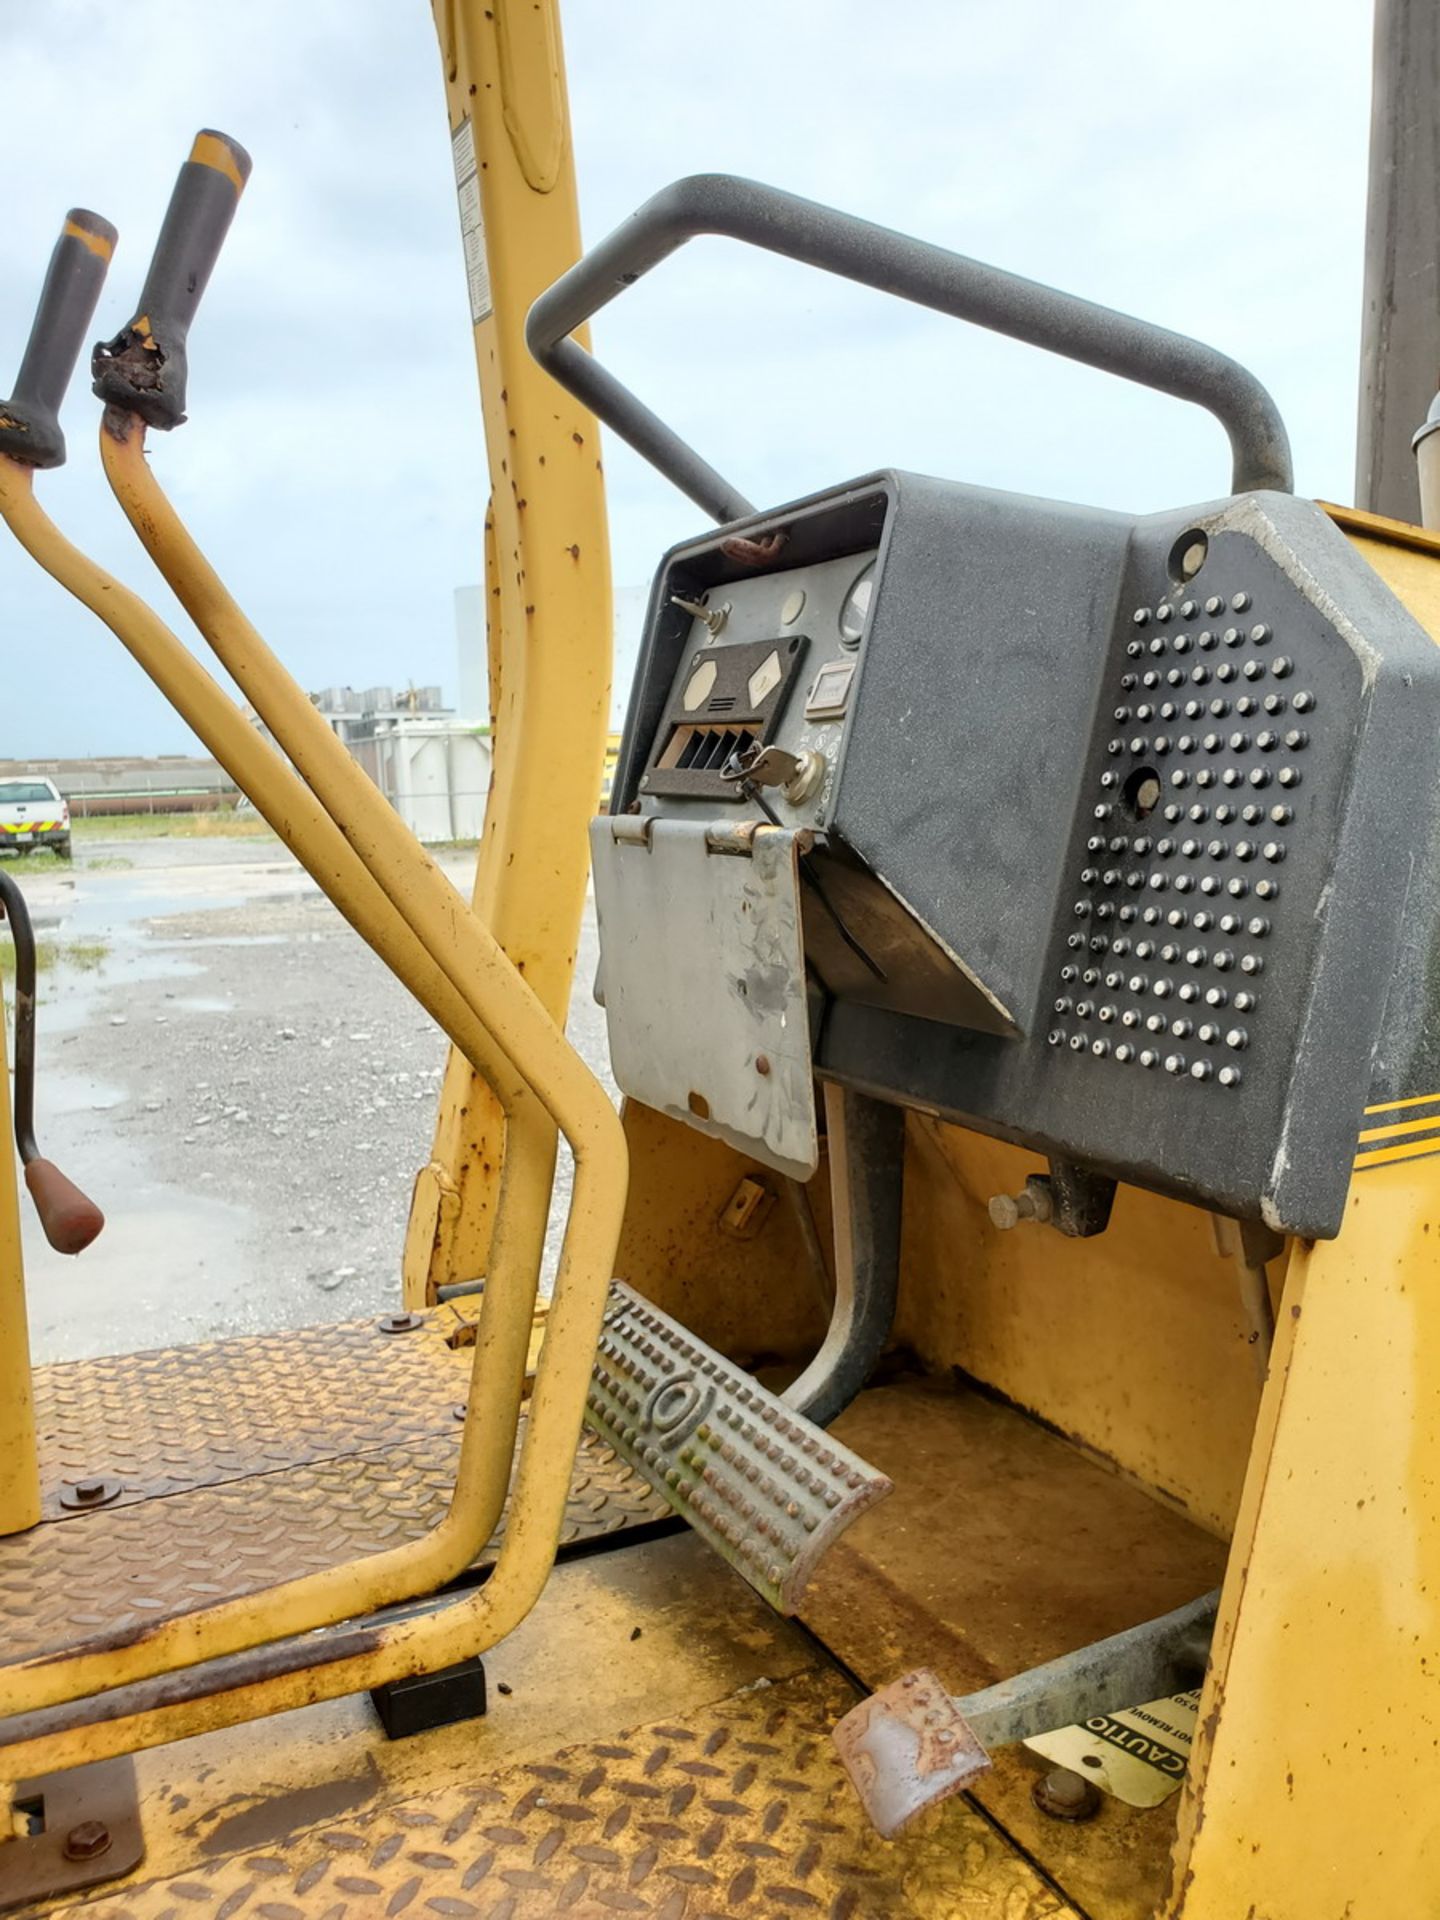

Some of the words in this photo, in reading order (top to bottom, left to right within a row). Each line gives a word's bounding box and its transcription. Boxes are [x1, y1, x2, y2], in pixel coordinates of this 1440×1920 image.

[1129, 1707, 1173, 1732] REMOVE
[1086, 1716, 1184, 1772] CAUTIO
[1172, 1729, 1193, 1744] NOT
